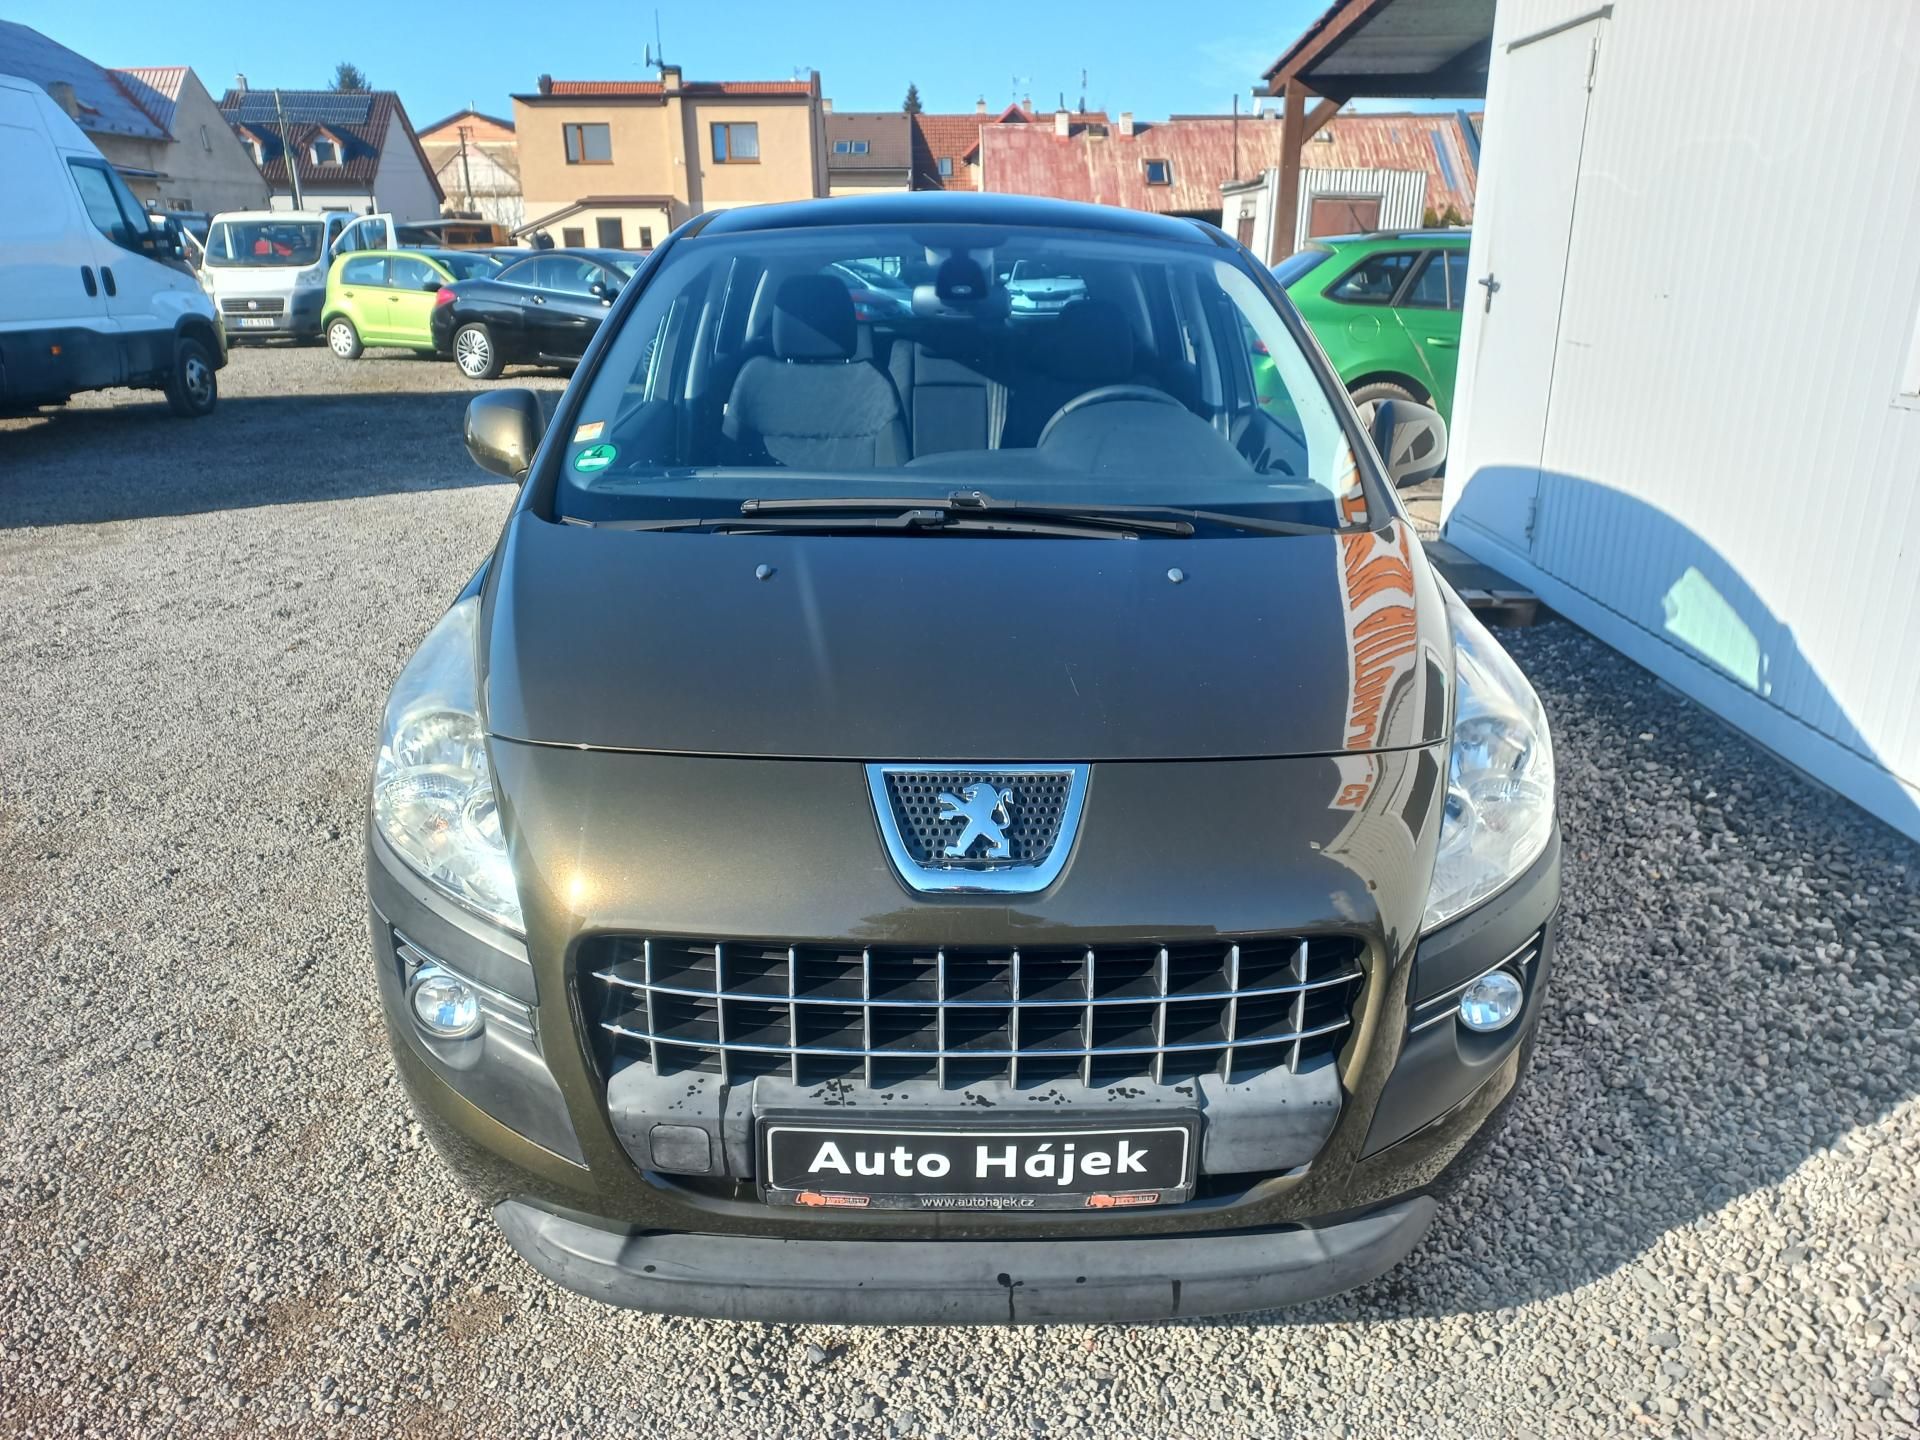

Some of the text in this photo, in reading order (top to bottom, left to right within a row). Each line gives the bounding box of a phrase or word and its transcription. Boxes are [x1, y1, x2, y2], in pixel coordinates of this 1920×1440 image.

[590, 446, 604, 458] 4
[808, 1140, 1147, 1186] Auto Hájek
[920, 1195, 1036, 1209] www.autohajek.cz
